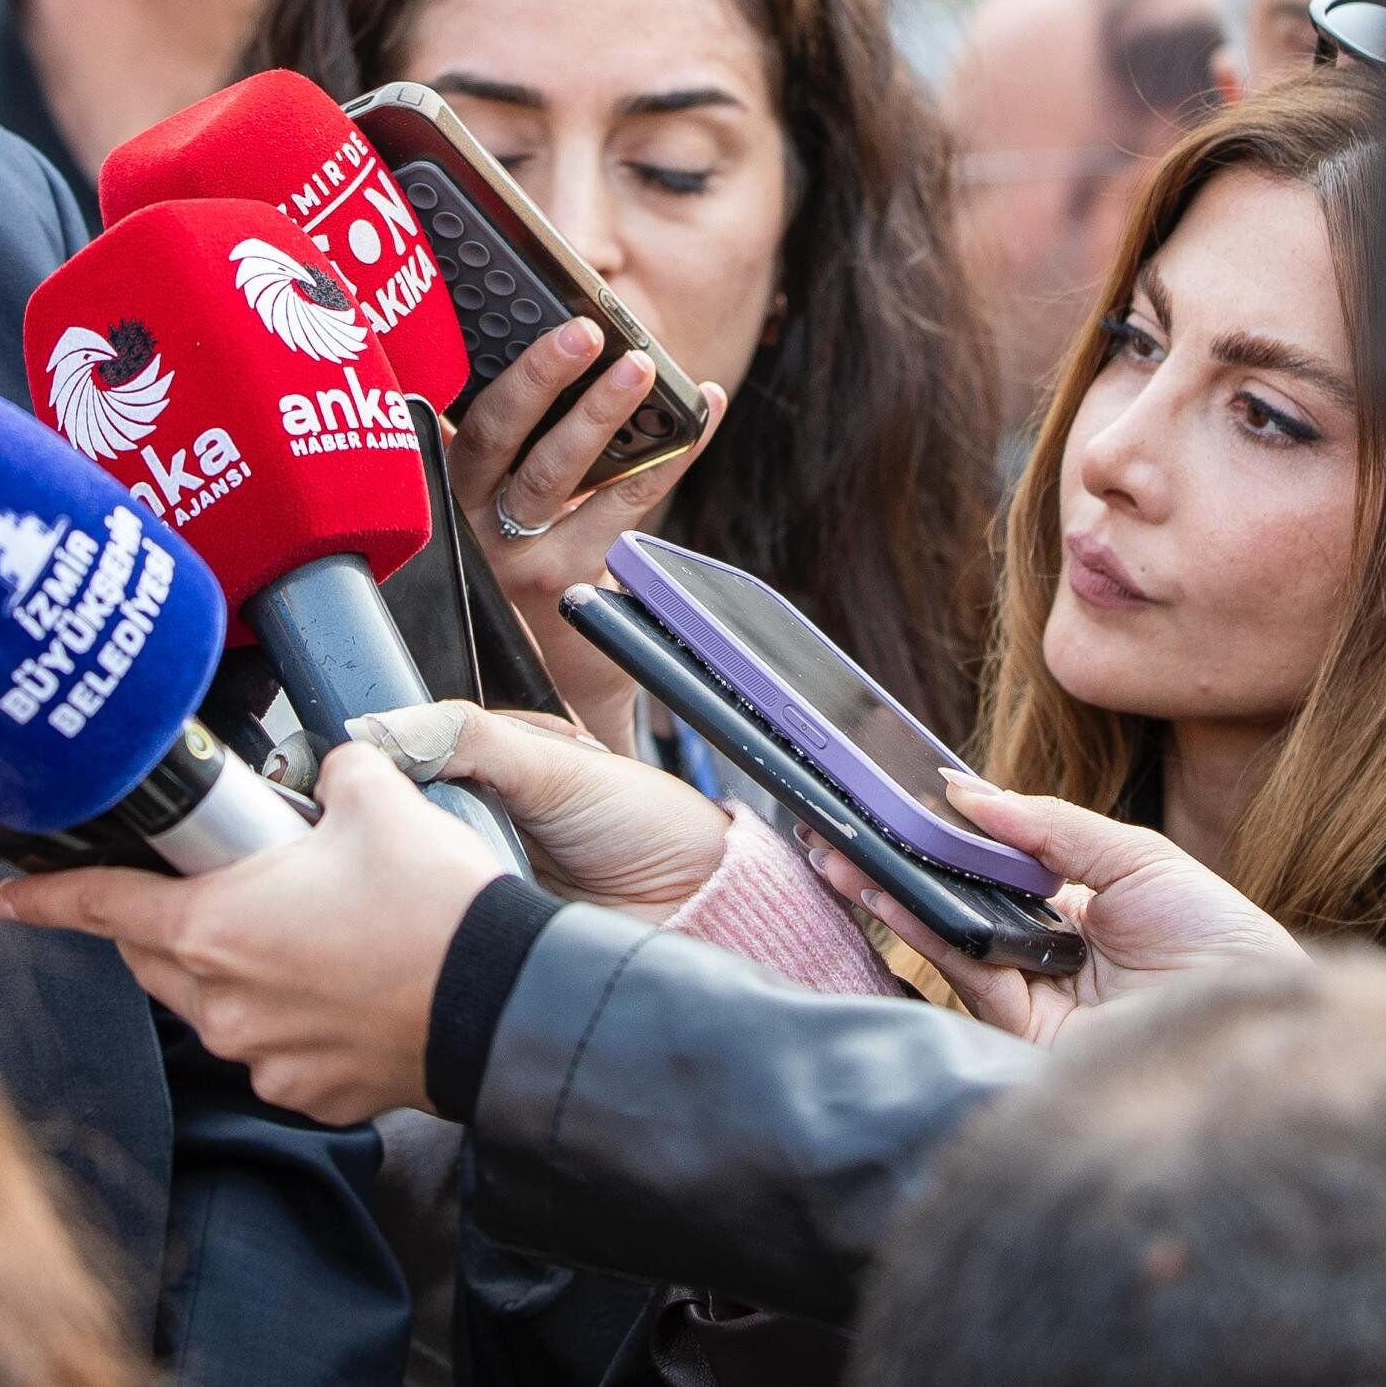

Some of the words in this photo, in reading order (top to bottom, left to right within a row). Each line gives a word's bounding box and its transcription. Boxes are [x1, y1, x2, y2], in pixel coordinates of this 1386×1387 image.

[277, 131, 369, 224] MİR'DE
[360, 244, 437, 335] AKİKA
[278, 366, 415, 436] anka
[290, 431, 362, 457] HABER
[129, 427, 241, 518] nka
[174, 461, 252, 527] AJANSI
[13, 529, 100, 641] İZMİR
